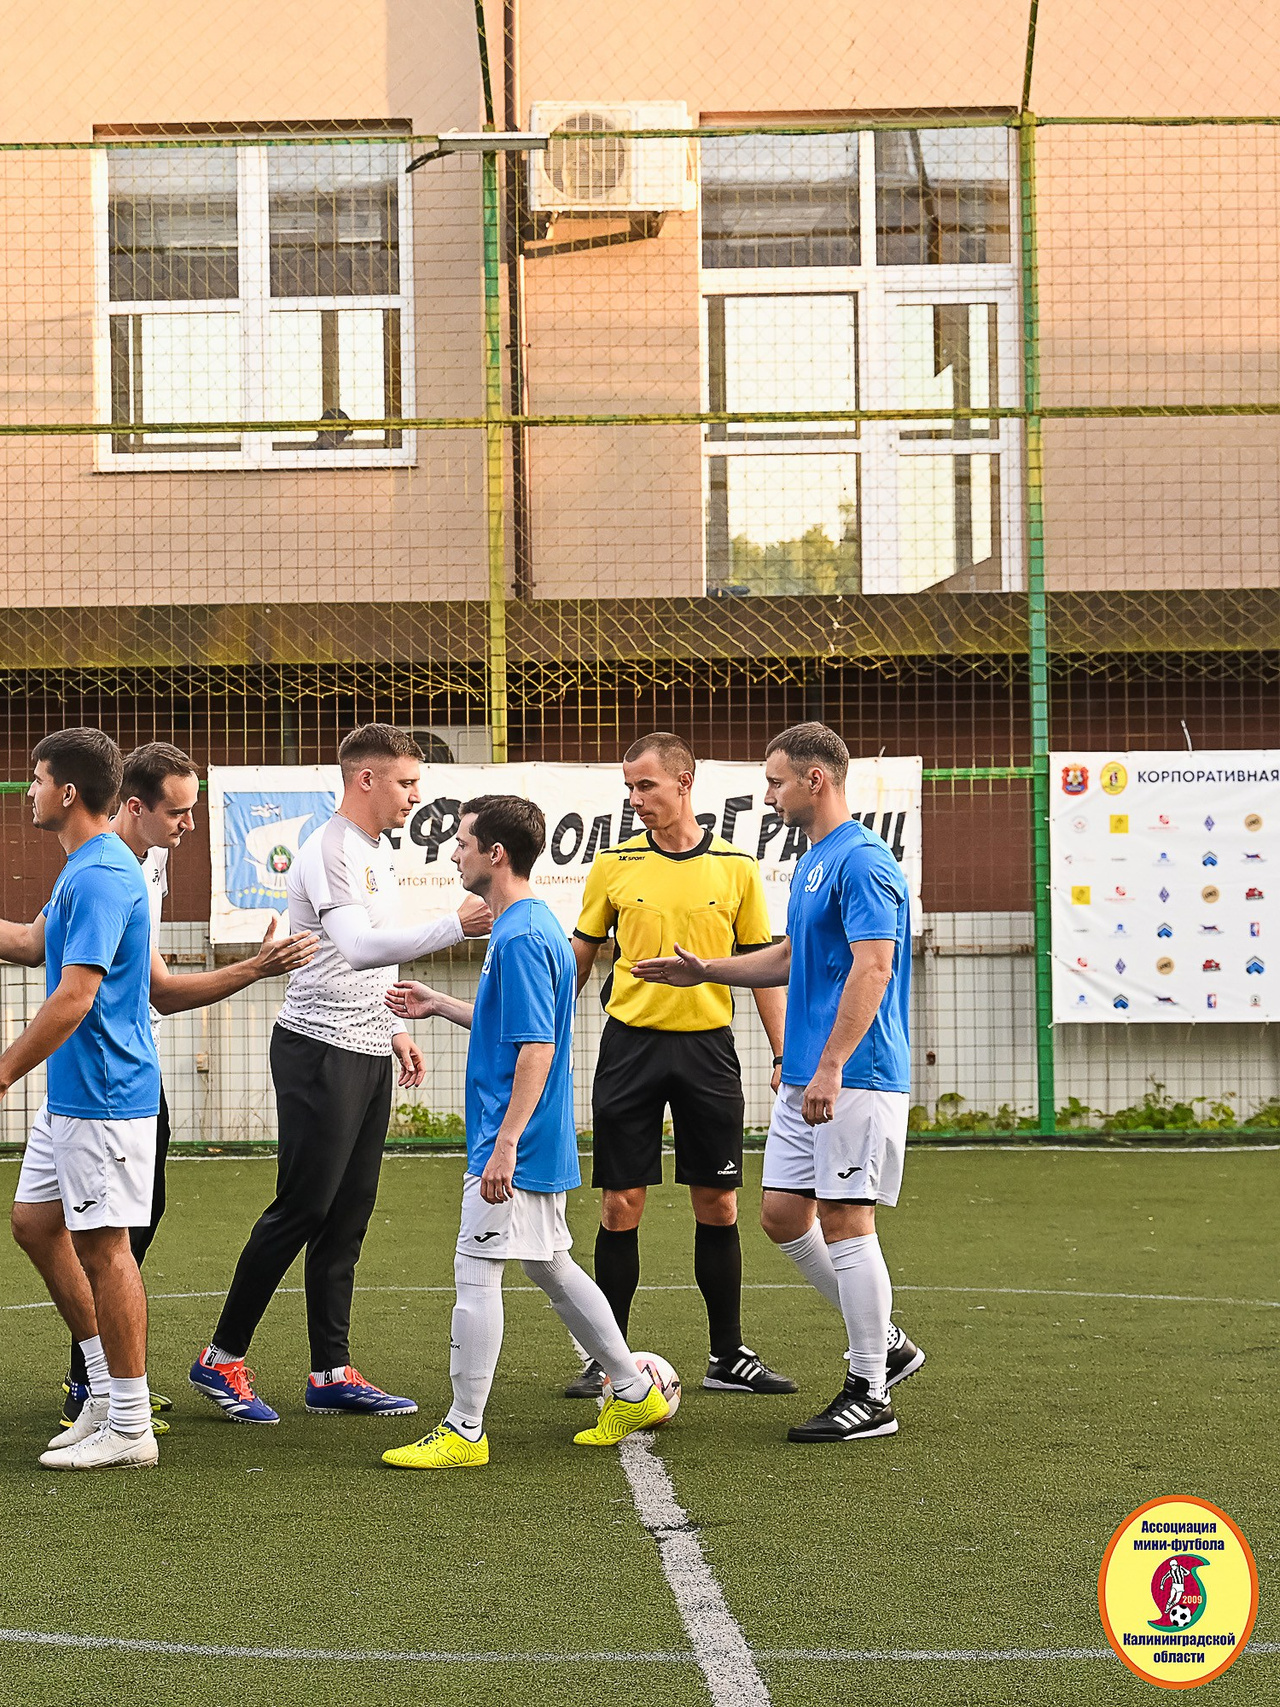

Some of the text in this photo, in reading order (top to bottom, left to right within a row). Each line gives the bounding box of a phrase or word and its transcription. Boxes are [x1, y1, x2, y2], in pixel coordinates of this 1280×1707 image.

[1137, 770, 1280, 783] КОРПОРАТИВНАЯ
[398, 876, 427, 887] ится
[431, 876, 455, 889] при
[535, 875, 587, 886] админи
